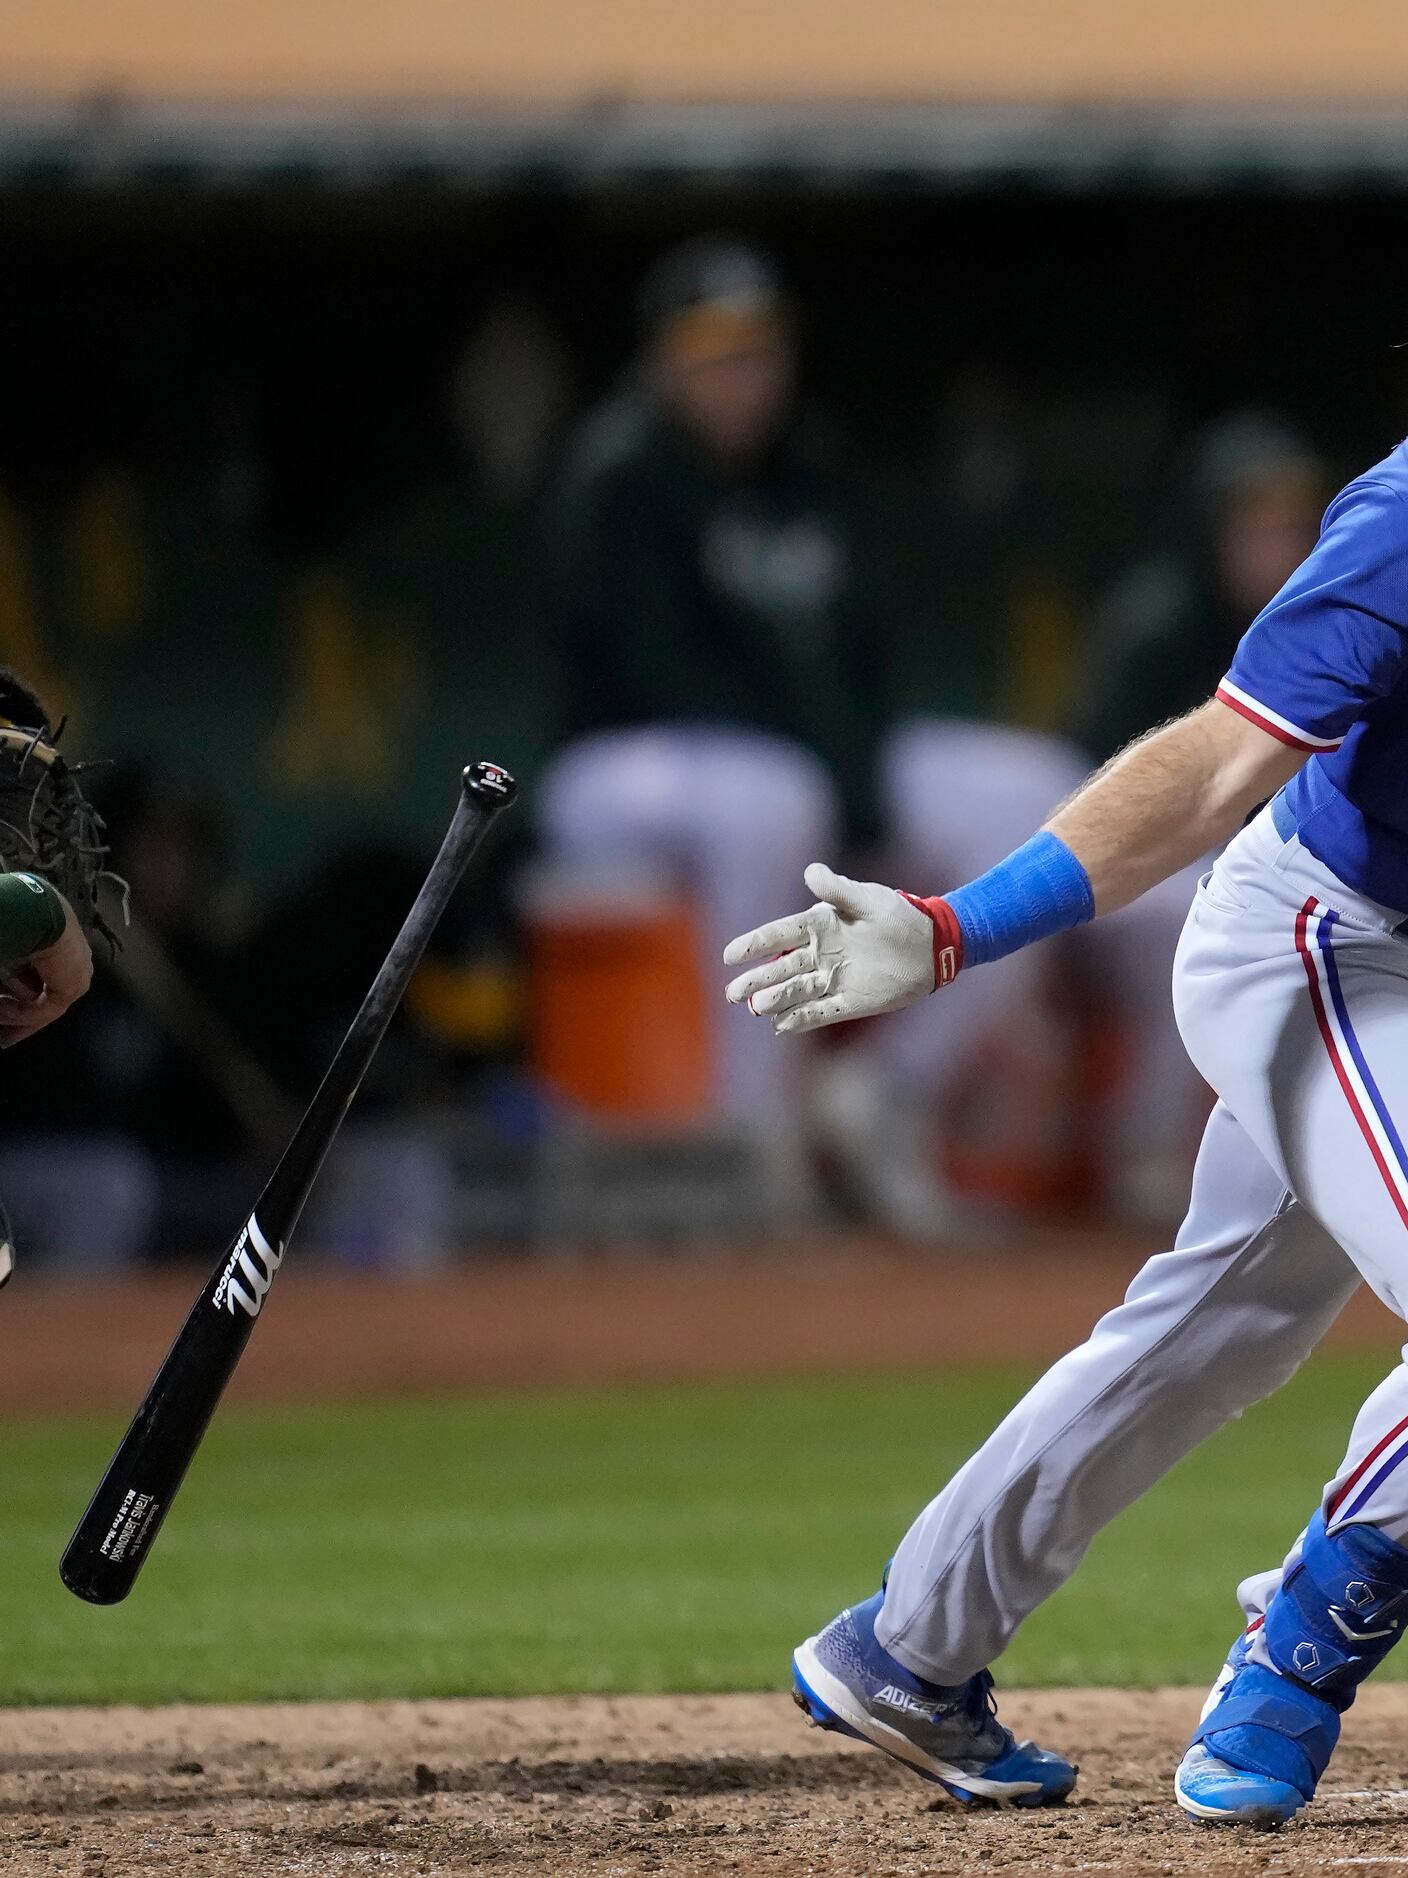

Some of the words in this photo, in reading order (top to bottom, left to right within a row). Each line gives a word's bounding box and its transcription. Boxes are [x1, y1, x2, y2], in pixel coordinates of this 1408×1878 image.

[131, 1494, 154, 1519] Travis
[112, 1513, 124, 1529] Pro
[109, 1518, 141, 1562] Jankowski
